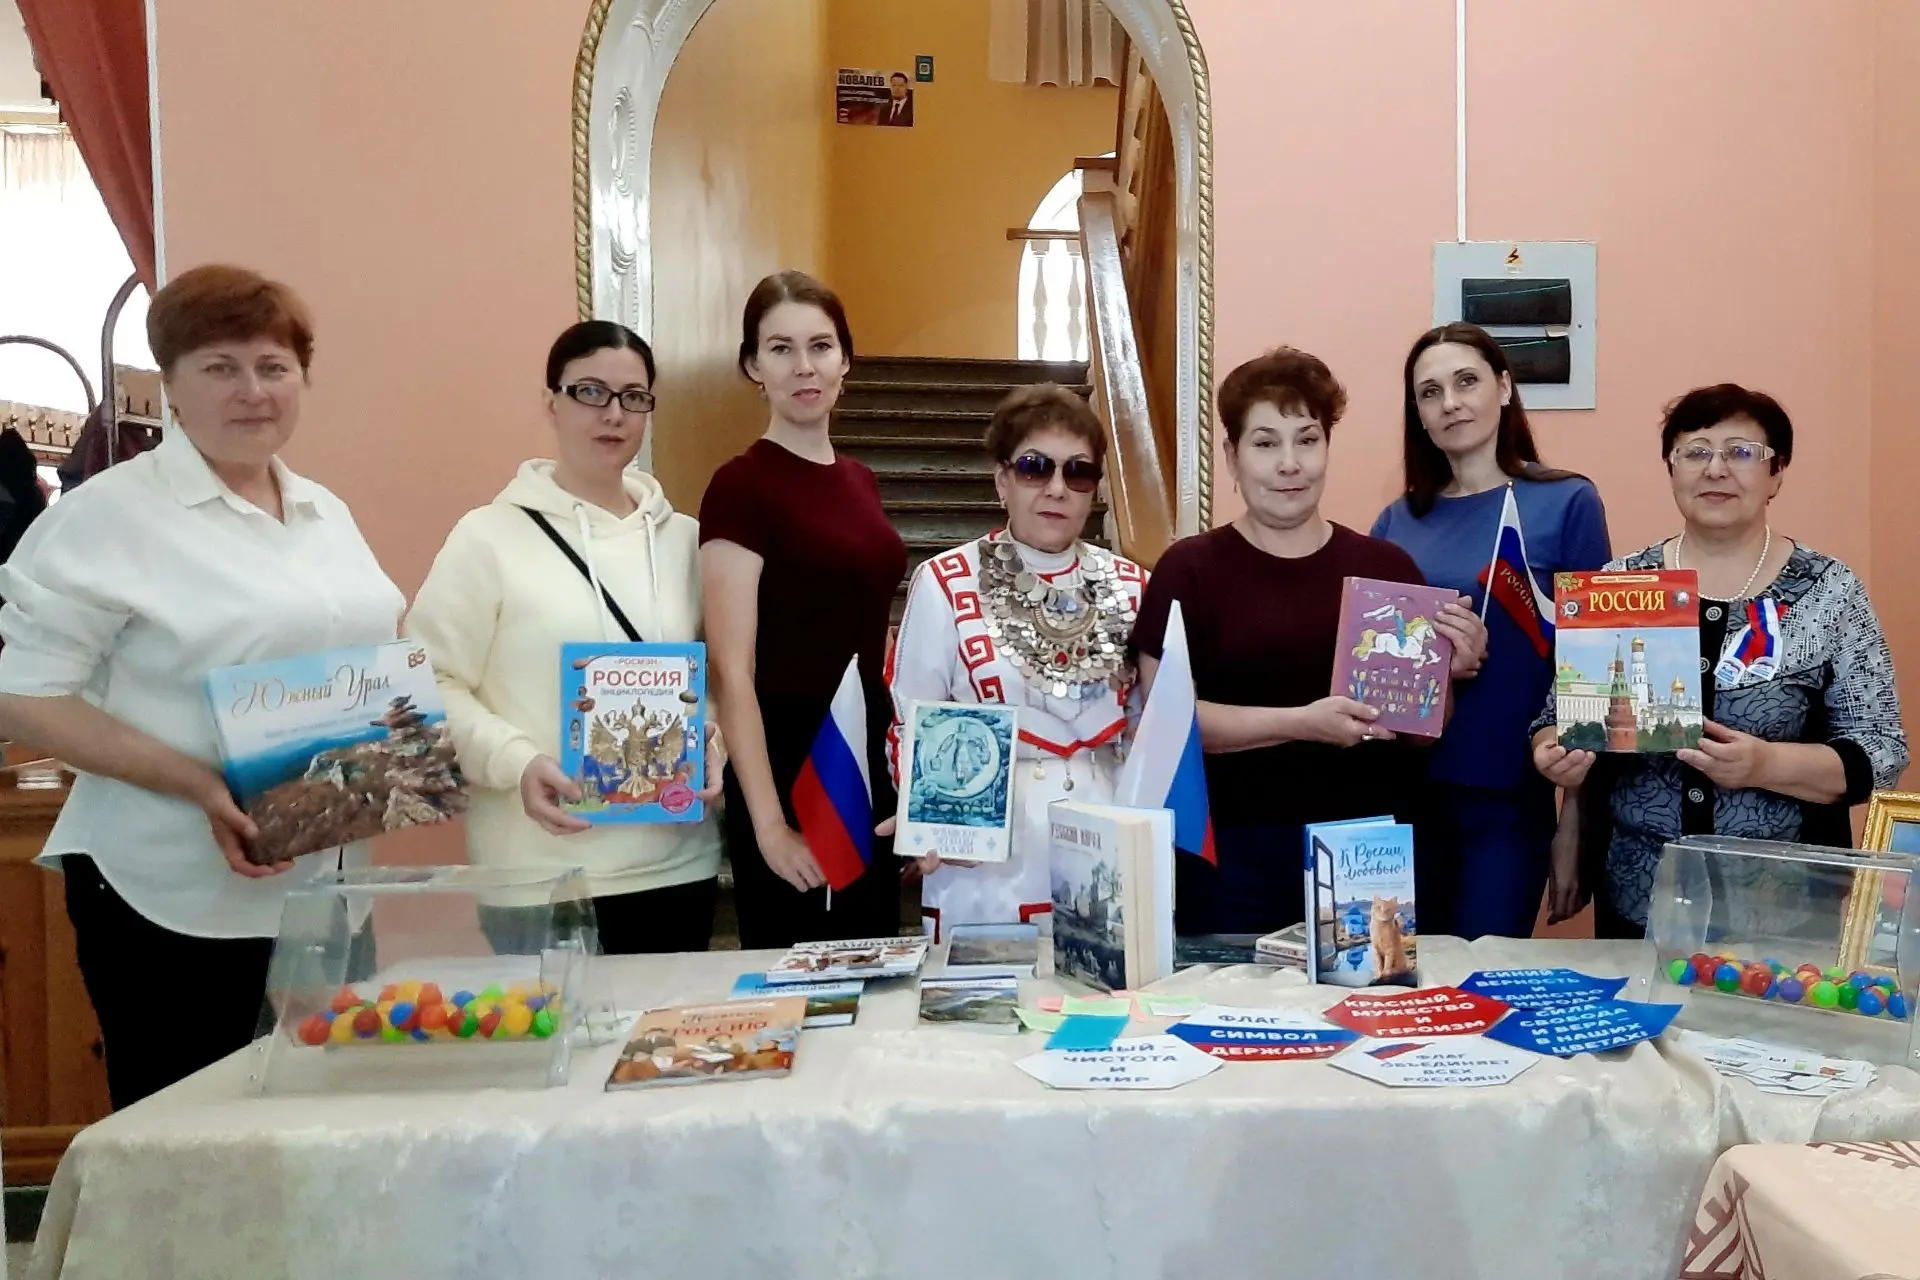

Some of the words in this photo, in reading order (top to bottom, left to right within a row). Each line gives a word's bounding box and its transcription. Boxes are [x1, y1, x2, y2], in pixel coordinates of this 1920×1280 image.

[1588, 590, 1667, 612] РОССИЯ
[592, 670, 682, 687] РОССИЯ
[1483, 969, 1554, 979] СИНИЙ
[1475, 977, 1581, 987] ВЕРНОСТЬ
[1344, 993, 1450, 1008] КРАСНЫЙ
[1490, 988, 1604, 1001] ЕДИНСТВО
[1513, 995, 1601, 1007] НАРОДА
[1351, 1002, 1476, 1017] МУЖЕСТВО
[1218, 1014, 1281, 1024] ФЛАГ
[1414, 1016, 1432, 1024] И
[1520, 1007, 1628, 1028] СВОБОДА
[1375, 1020, 1486, 1036] ГЕРОИЗМ
[1532, 1028, 1549, 1036] И
[1554, 1019, 1612, 1034] ВЕРА
[1535, 1037, 1551, 1045] В
[1556, 1022, 1642, 1043] НАШИХ
[1210, 1030, 1318, 1041] СИМВОЛ
[1552, 1030, 1649, 1054] ЦВЕТАХ!
[1209, 1045, 1335, 1056] ДЕРЖАВЫ
[1063, 1055, 1178, 1063] ЧИСТОТА
[1380, 1060, 1510, 1068] ОБЪЕДИНЯЕТ
